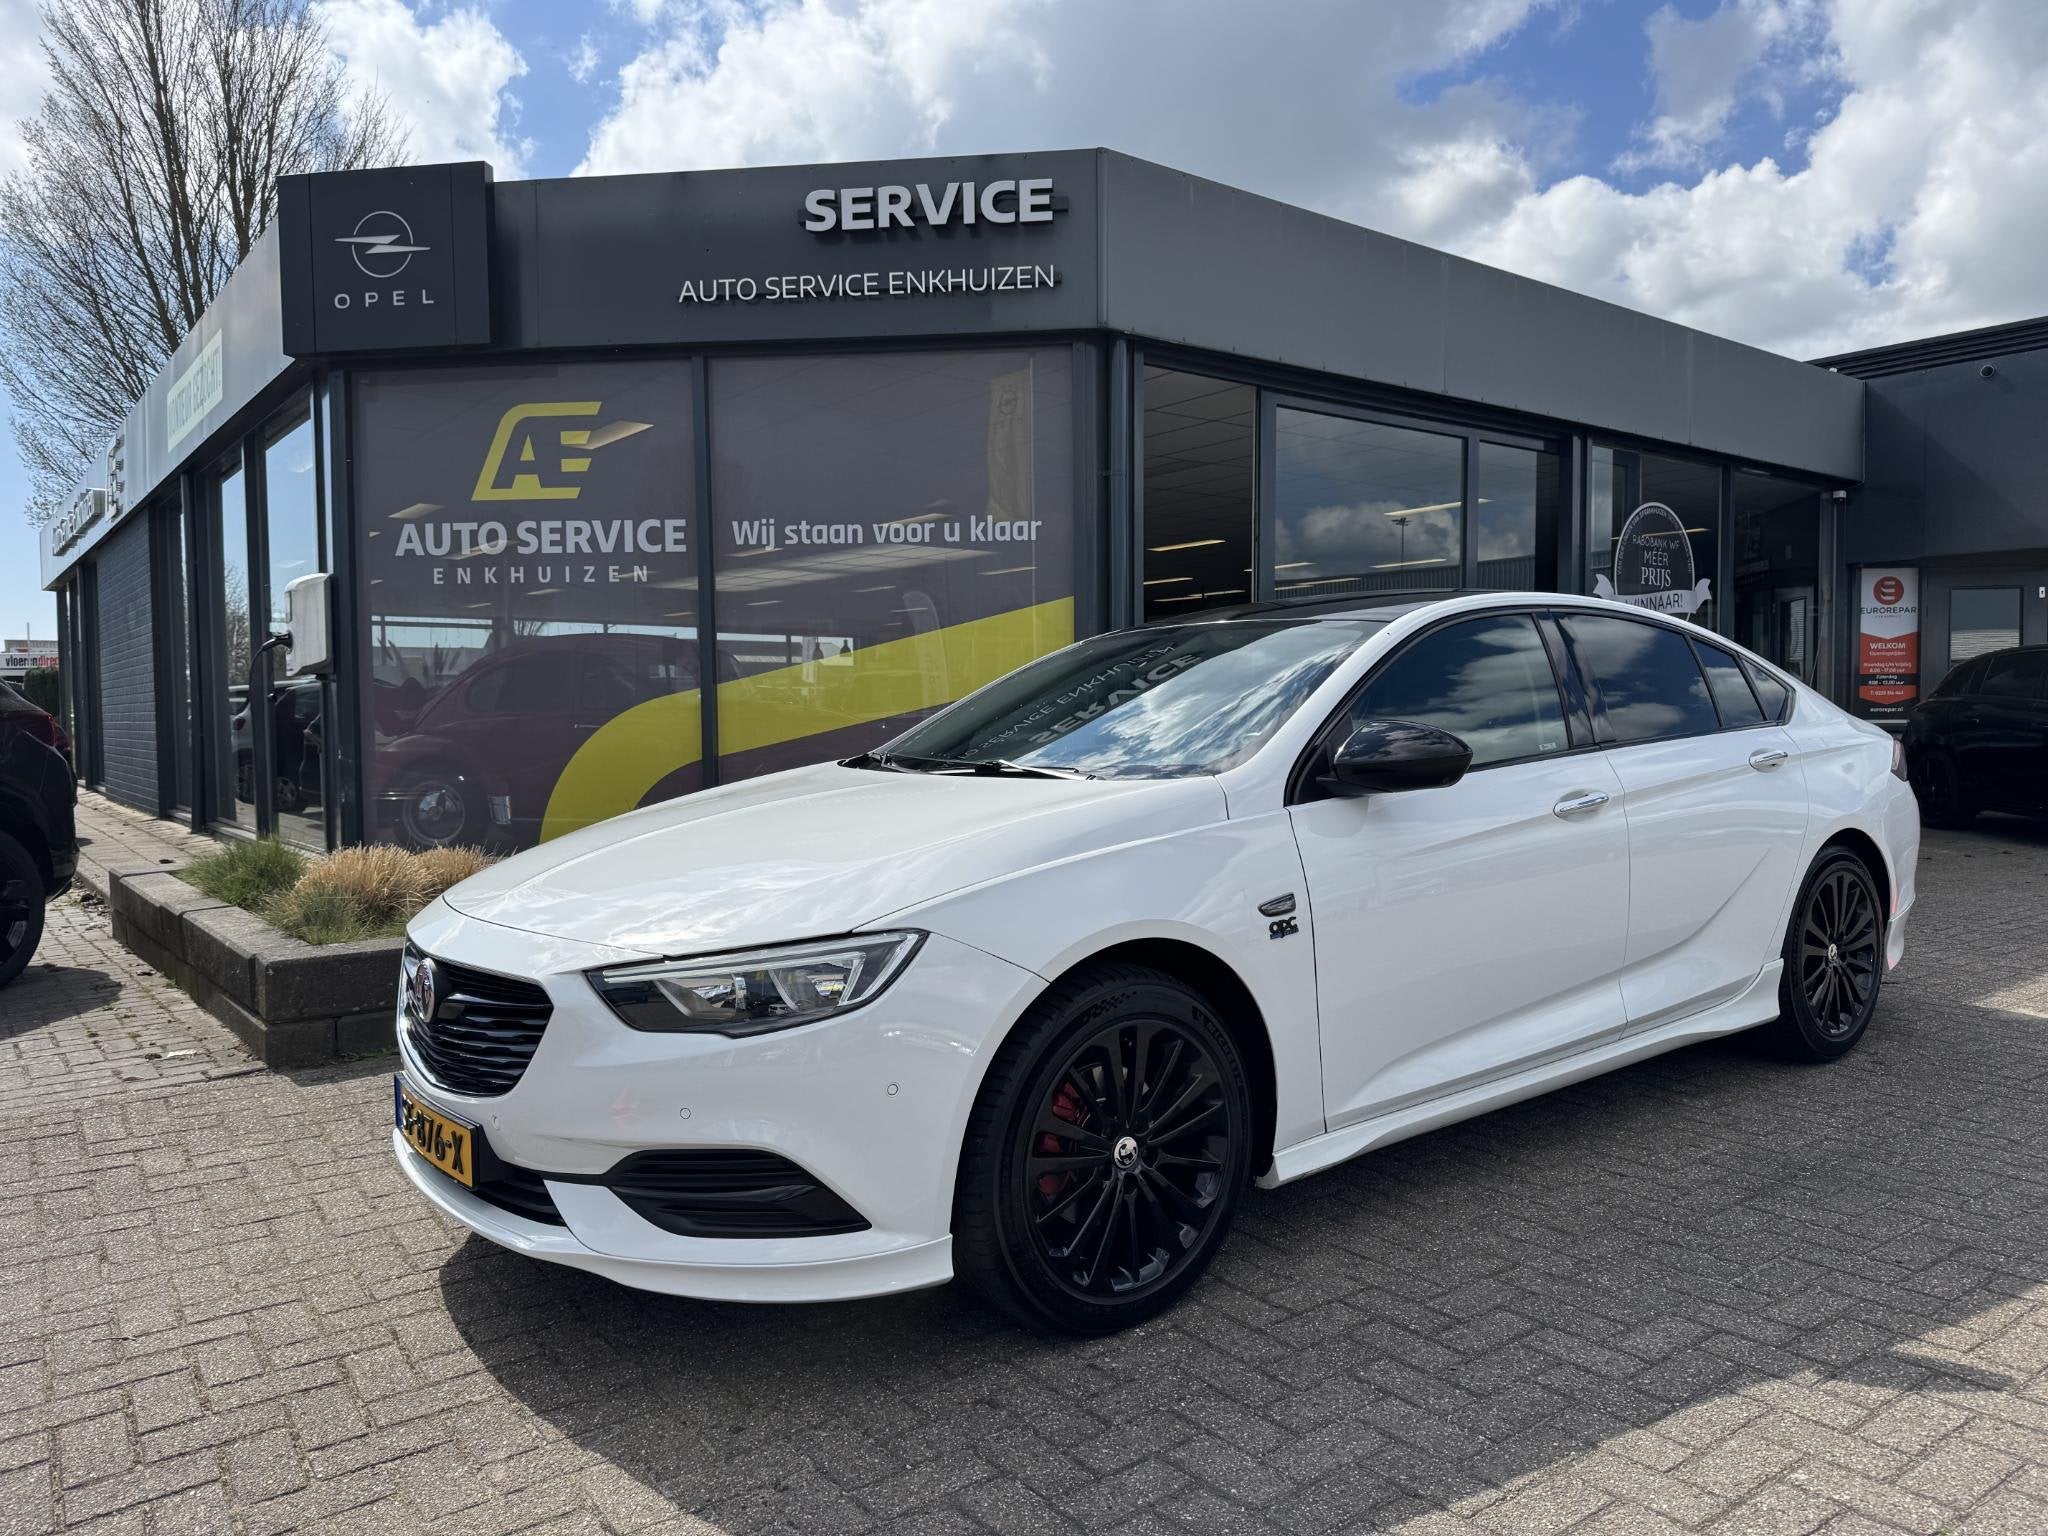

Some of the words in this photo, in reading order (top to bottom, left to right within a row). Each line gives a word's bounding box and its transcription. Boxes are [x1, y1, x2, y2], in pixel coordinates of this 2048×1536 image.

[804, 178, 1055, 233] SERVICE
[678, 277, 758, 304] AUTO
[765, 271, 880, 301] SERVICE
[887, 264, 1056, 296] ENKHUIZEN
[333, 289, 434, 310] OPEL
[395, 521, 508, 557] AUTO
[516, 518, 687, 556] SERVICE
[732, 519, 776, 550] Wij
[785, 521, 864, 545] staan
[872, 520, 935, 545] voor
[943, 520, 961, 543] u
[970, 514, 1043, 542] klaar
[1632, 534, 1668, 549] RABOBANK
[432, 564, 650, 586] ENKHUIZEN
[1640, 566, 1672, 590] PRIJS
[1860, 606, 1917, 615] EUROREPAR
